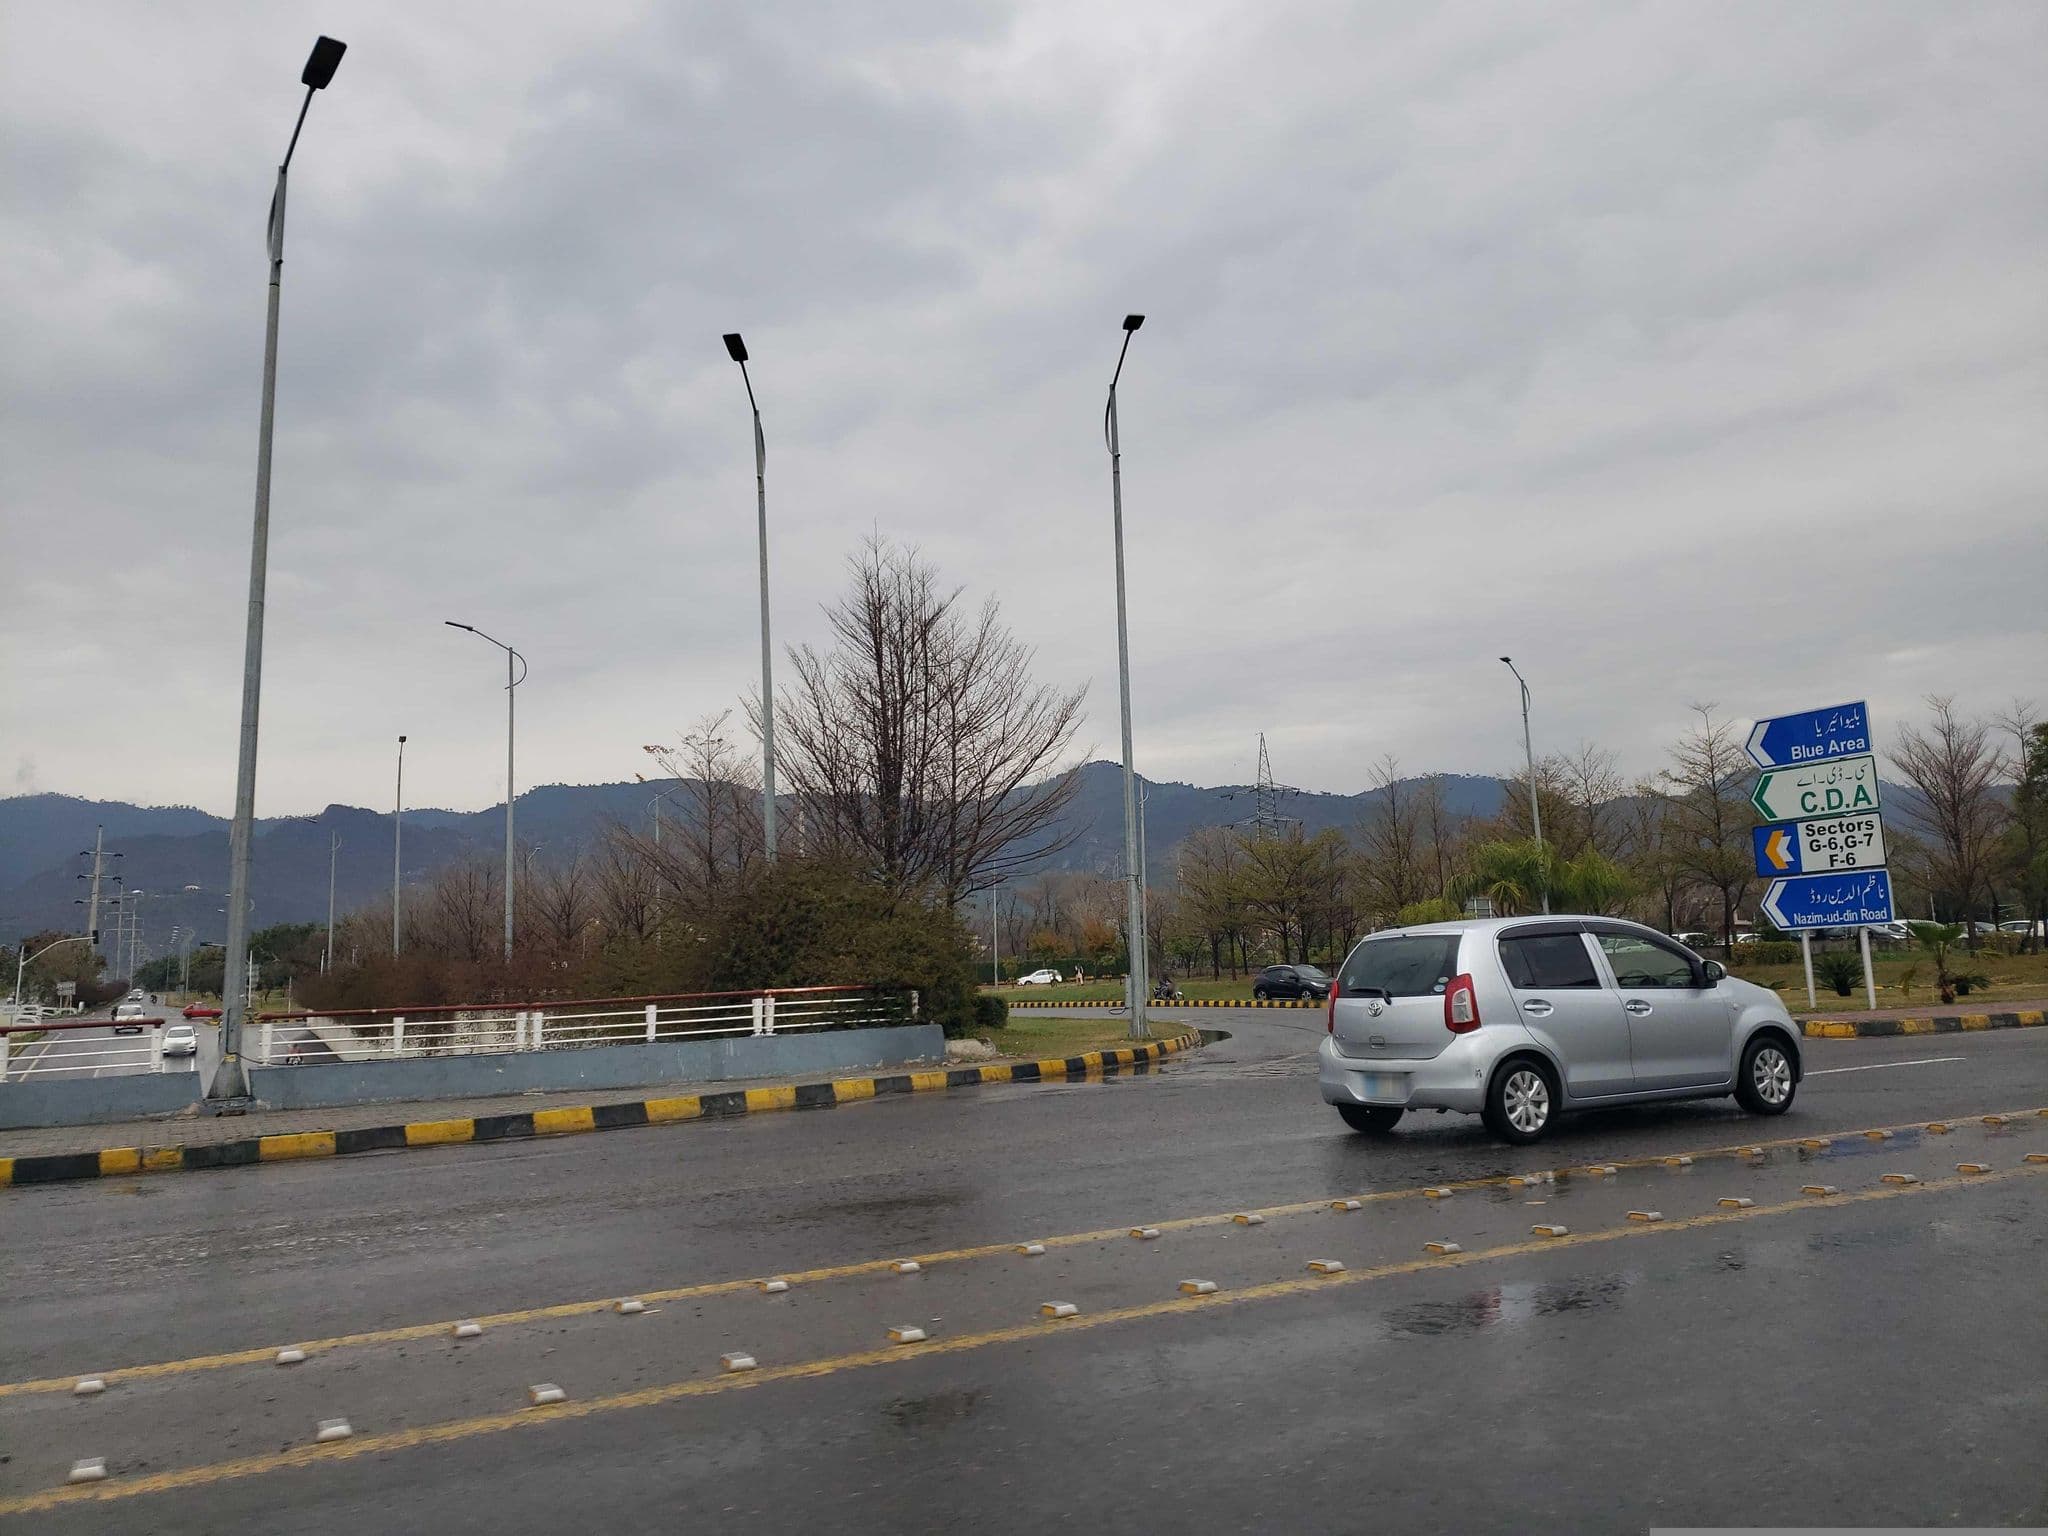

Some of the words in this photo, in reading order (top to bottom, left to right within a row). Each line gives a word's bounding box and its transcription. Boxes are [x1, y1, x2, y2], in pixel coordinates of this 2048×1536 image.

[1791, 744, 1824, 760] Blue
[1828, 738, 1866, 754] Area
[1801, 784, 1873, 813] C.D.A
[1805, 820, 1874, 837] Sectors
[1809, 833, 1874, 852] G-6,G-7
[1829, 852, 1856, 868] F-6
[1793, 909, 1858, 925] Nazim-ud-din
[1860, 906, 1888, 921] Road
